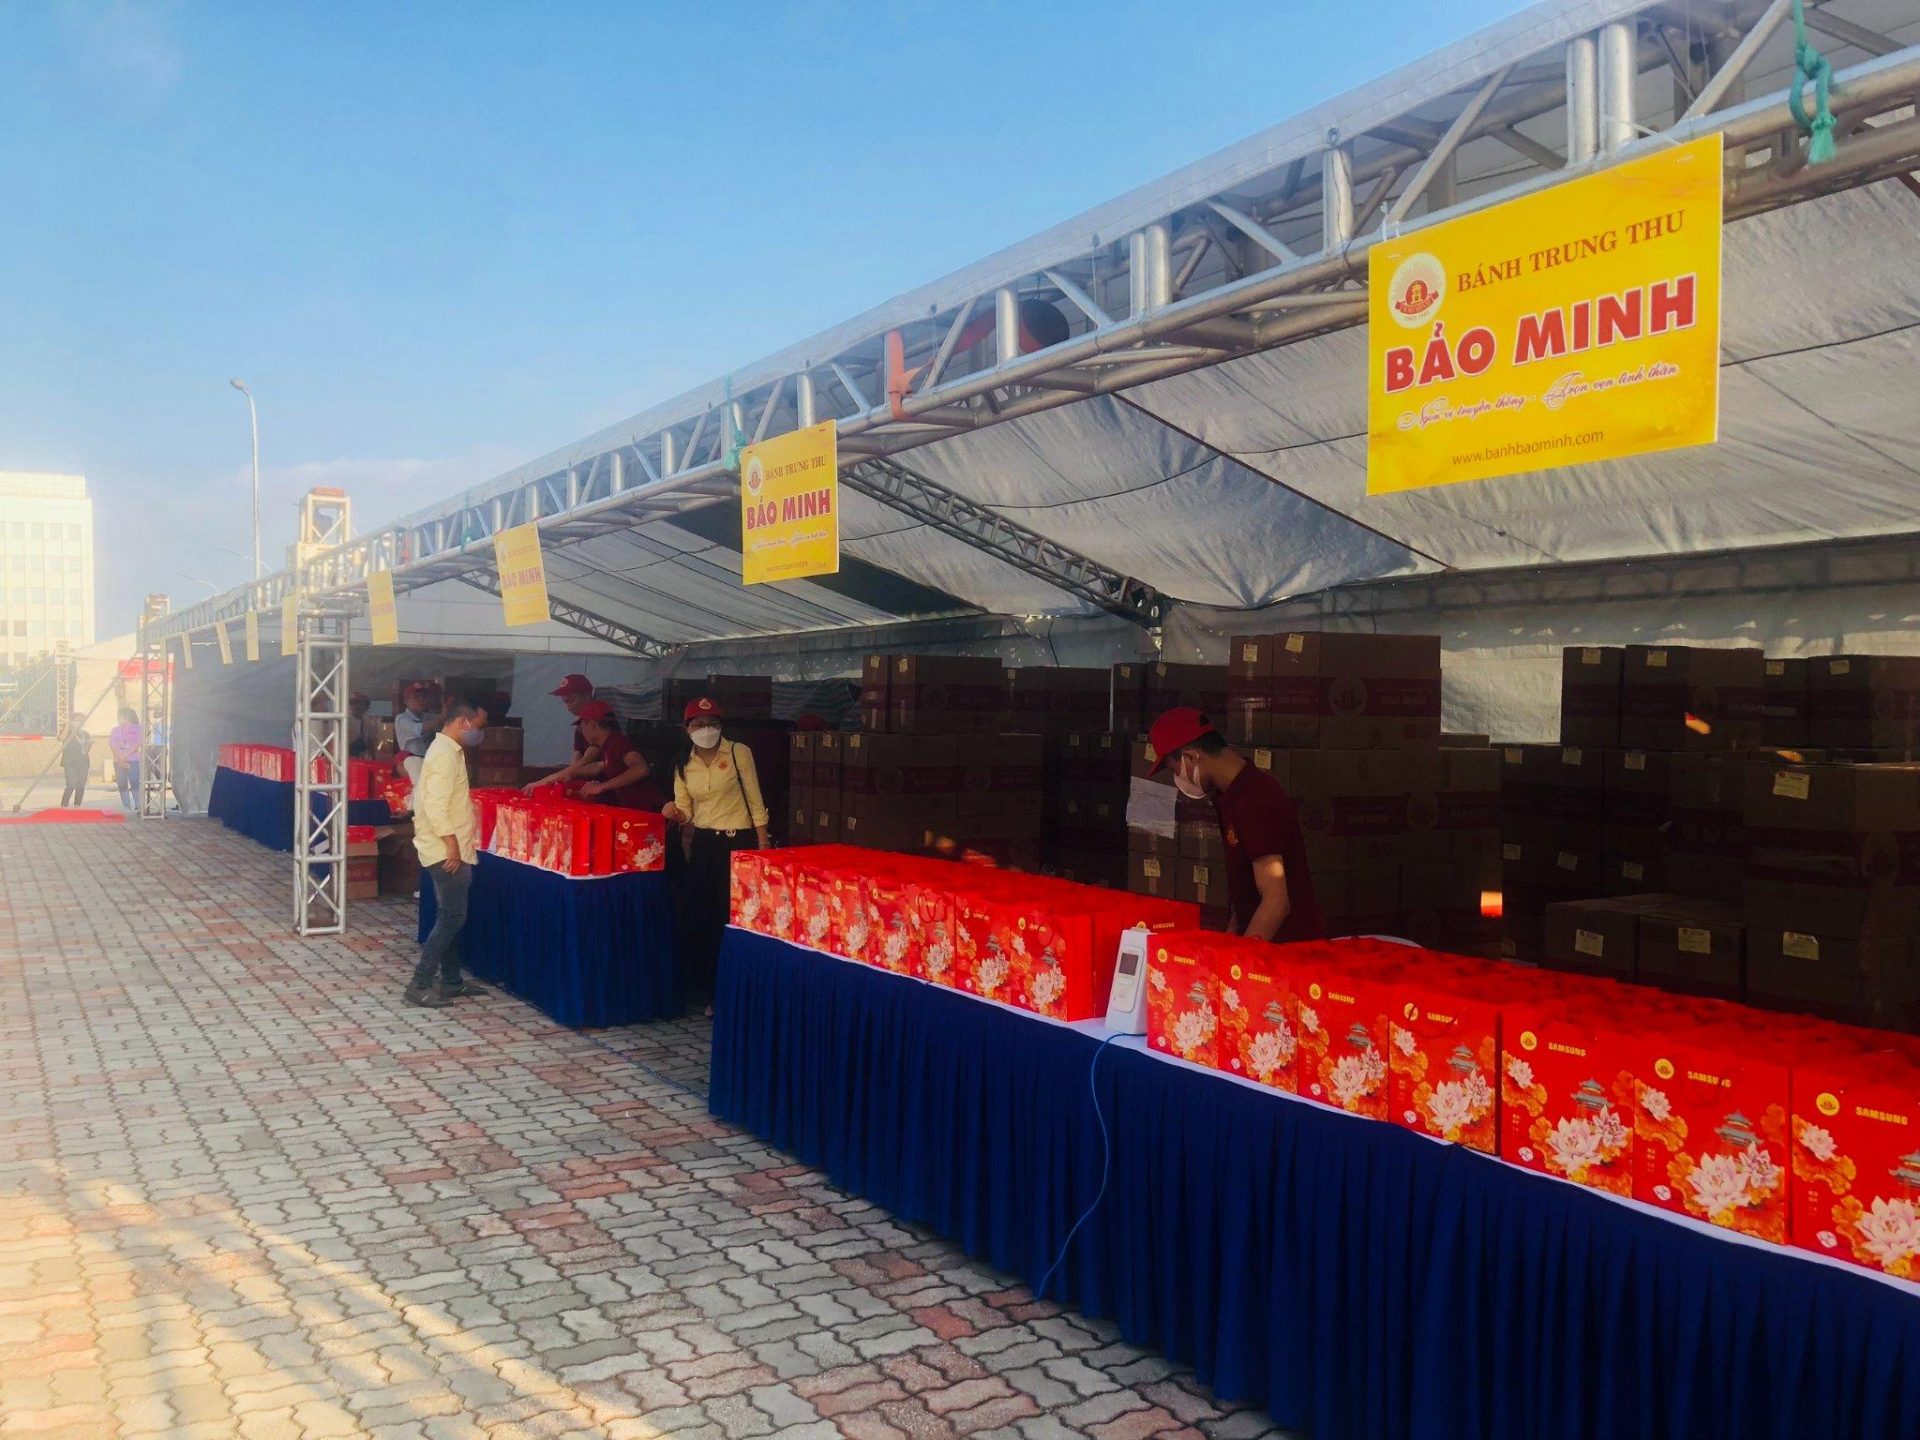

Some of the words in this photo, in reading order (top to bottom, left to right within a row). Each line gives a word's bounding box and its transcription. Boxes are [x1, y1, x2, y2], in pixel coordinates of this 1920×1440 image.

[1457, 257, 1522, 293] BÁNH
[1528, 231, 1618, 274] TRUNG
[1625, 210, 1686, 246] THU
[1385, 321, 1496, 394] BẢO
[1513, 273, 1697, 366] MINH
[1451, 430, 1604, 466] www.banhbaominh.com
[785, 459, 810, 477] TRUNG
[746, 495, 777, 530] BẢO
[782, 488, 831, 522] MINH
[1327, 991, 1355, 1005] SAMSUNG
[1548, 1041, 1587, 1058] SAMSUNG
[1855, 1106, 1909, 1126] SAMSUNG
